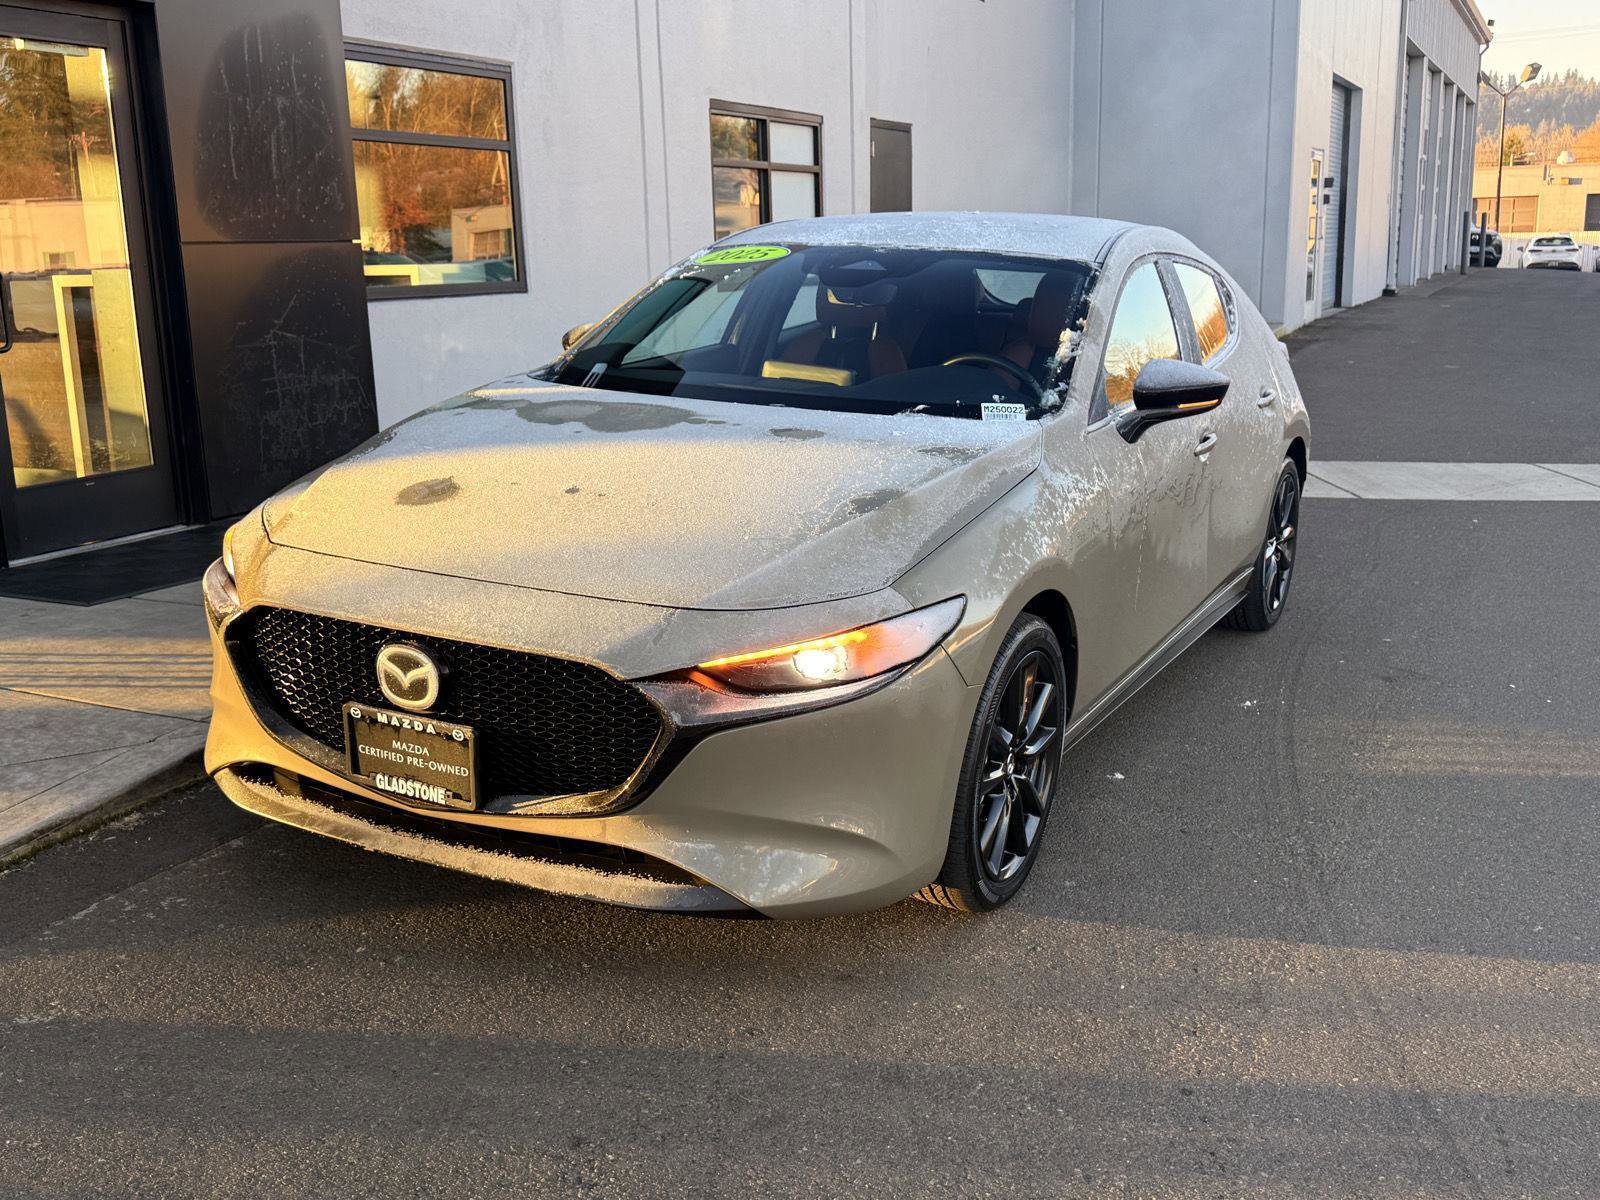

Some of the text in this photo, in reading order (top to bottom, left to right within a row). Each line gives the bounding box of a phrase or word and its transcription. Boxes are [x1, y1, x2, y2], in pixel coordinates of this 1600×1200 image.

[704, 249, 778, 262] 2025
[984, 405, 1024, 414] M250022
[377, 712, 436, 735] MAZDA
[392, 740, 430, 756] MAZDA
[358, 744, 469, 777] CERTIFIED PRE-OWNED
[375, 773, 446, 805] GLADSTONE
